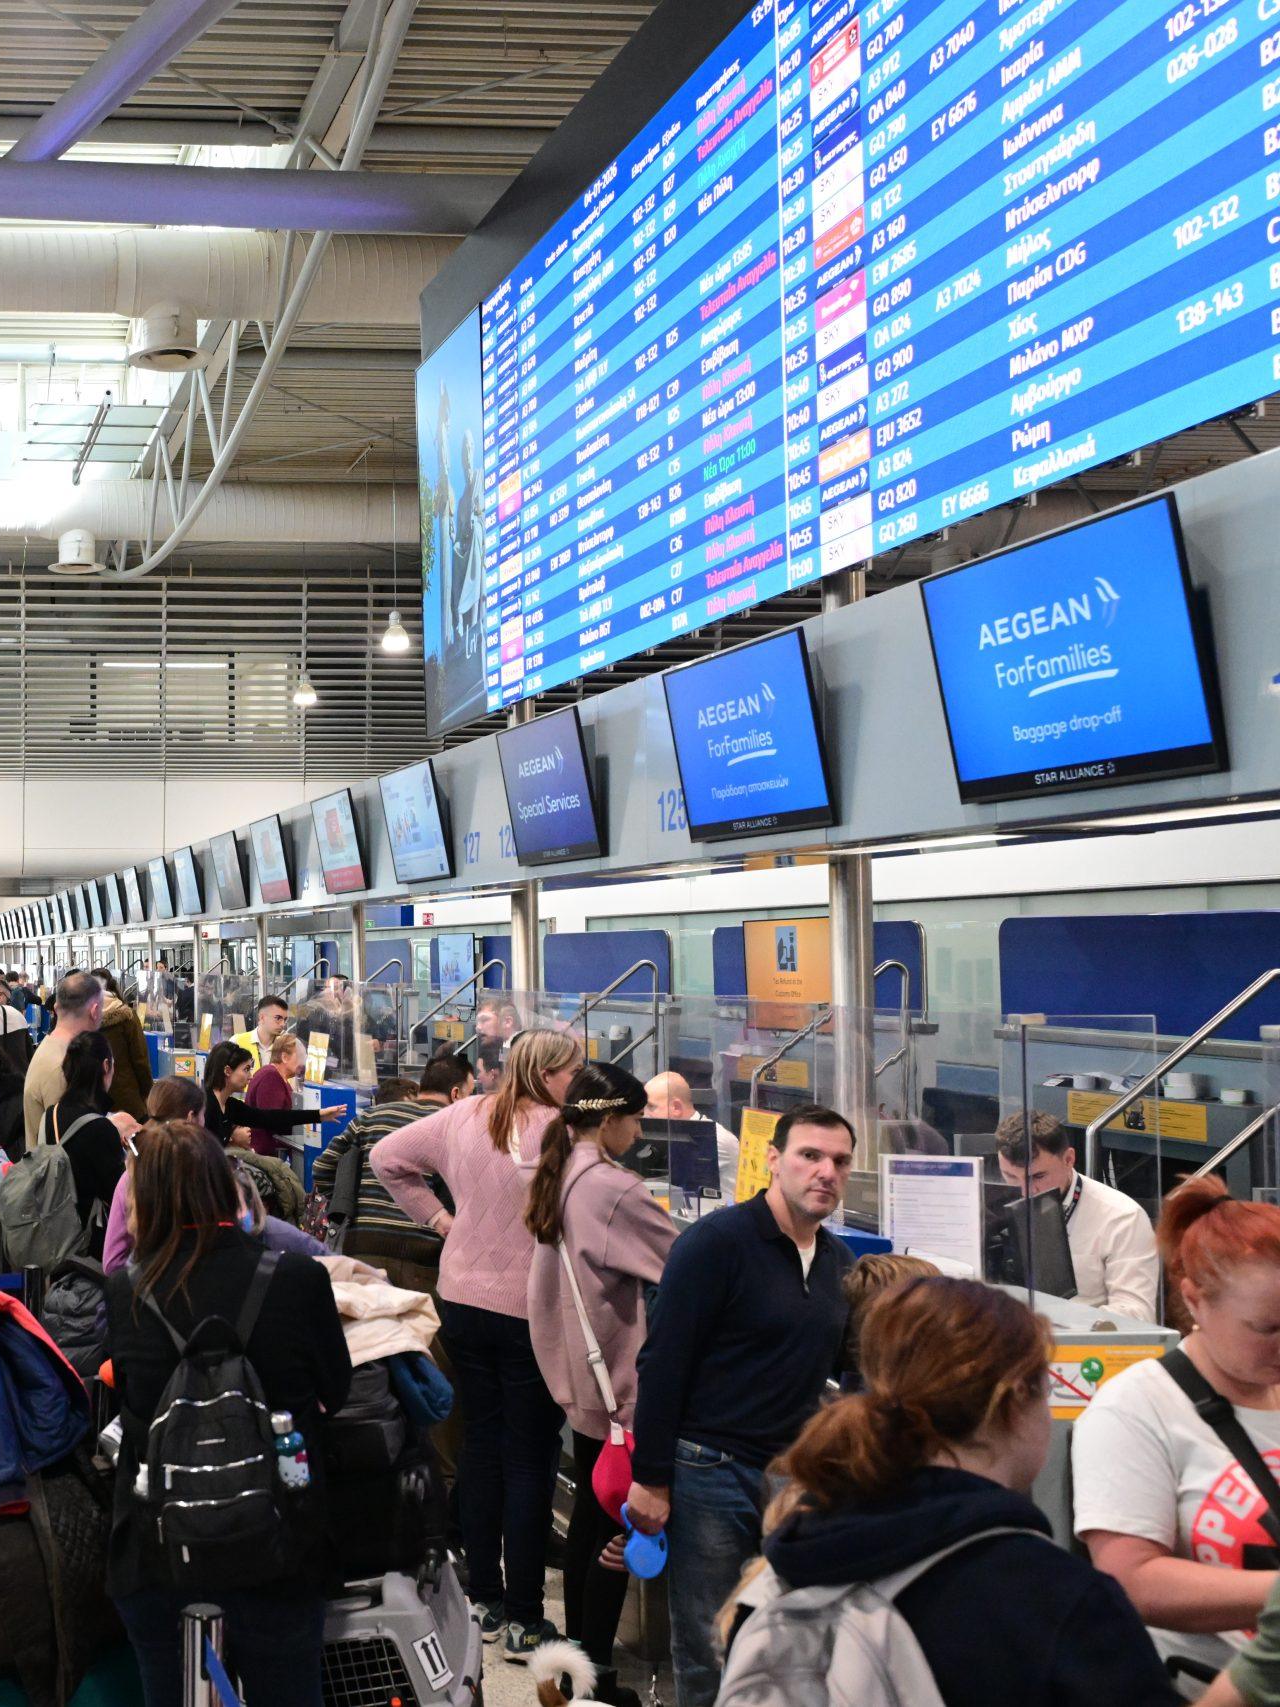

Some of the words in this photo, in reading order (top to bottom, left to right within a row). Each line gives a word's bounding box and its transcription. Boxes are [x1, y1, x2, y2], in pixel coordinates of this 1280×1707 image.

[867, 34, 884, 61] GQ
[885, 14, 904, 46] 700
[928, 47, 945, 75] A3
[946, 20, 976, 60] 7040
[1166, 17, 1239, 84] 026-028
[780, 48, 802, 81] 10:10
[1000, 40, 1045, 88] Ικαρία
[813, 98, 850, 138] AEGEAN
[868, 100, 885, 125] OA
[885, 79, 907, 110] 040
[780, 107, 803, 139] 10:25
[931, 114, 947, 142] EY
[1003, 102, 1065, 160] Ιωάννινα
[869, 131, 886, 157] GQ
[781, 167, 805, 198] 10:30
[870, 163, 887, 189] GQ
[888, 145, 908, 175] 450
[697, 194, 713, 216] Νέα
[713, 174, 733, 203] Πύλη
[871, 231, 886, 254] A3
[887, 214, 907, 242] 160
[1172, 194, 1240, 250] 102-132
[783, 226, 806, 256] 10:30
[816, 253, 854, 289] AEGEAN
[1007, 265, 1054, 306] Παρίσι
[1055, 241, 1087, 277] CDG
[784, 285, 807, 315] 10:35
[873, 292, 890, 317] GQ
[891, 278, 913, 306] 890
[1175, 281, 1245, 333] 138-143
[786, 345, 808, 374] 10:35
[874, 358, 892, 382] GQ
[892, 344, 914, 372] 900
[1009, 338, 1059, 379] Μιλάνο
[1061, 316, 1095, 352] MXP
[702, 407, 718, 429] Νέα
[717, 400, 735, 420] ώρα
[734, 380, 757, 407] 13:00
[786, 405, 810, 432] 10:40
[820, 411, 858, 441] AEGEAN
[876, 422, 896, 448] EJU
[896, 407, 923, 438] 3652
[1011, 419, 1051, 452] Ρώμη
[703, 463, 718, 483] Νέα
[736, 438, 757, 463] 11:00
[788, 466, 811, 492] 10:45
[821, 474, 860, 502] AEGEAN
[878, 489, 896, 512] GQ
[896, 478, 918, 504] 820
[941, 496, 958, 519] EY
[790, 529, 813, 551] 10:55
[978, 593, 1092, 651] AEGEAN
[994, 643, 1113, 689] ForFamilies
[697, 693, 761, 730] AEGEAN
[1012, 716, 1067, 743] Baggage
[1069, 704, 1122, 732] drop-off
[707, 728, 774, 760] ForFamilies
[518, 753, 556, 779] AEGEAN
[1034, 771, 1058, 786] STAR
[1058, 764, 1105, 781] ALLIANCE
[517, 797, 547, 823] Special
[545, 792, 581, 817] Services
[711, 783, 748, 802] Παράδοση
[745, 817, 773, 829] ALLIANCE
[463, 831, 481, 865] 127
